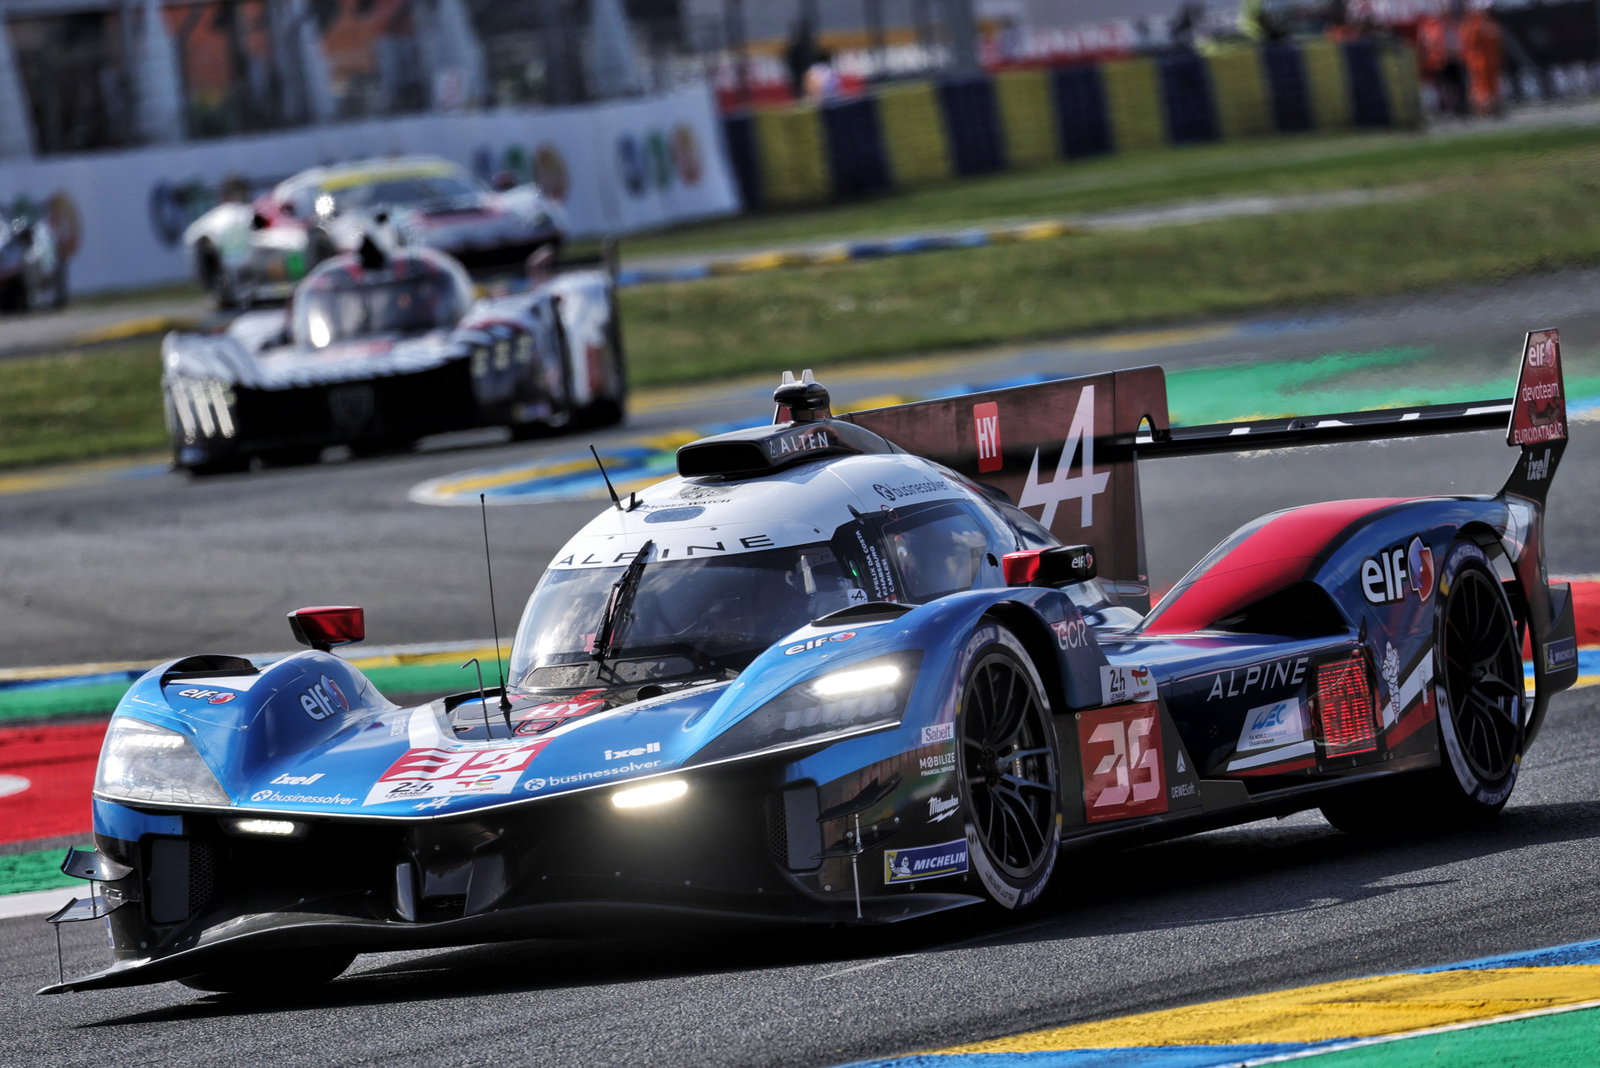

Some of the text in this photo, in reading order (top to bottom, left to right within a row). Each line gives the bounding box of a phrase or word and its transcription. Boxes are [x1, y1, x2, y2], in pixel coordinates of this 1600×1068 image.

[1528, 344, 1545, 367] elf
[1522, 382, 1559, 402] devoteam
[780, 431, 829, 454] ALTEN
[976, 415, 998, 459] HY
[1514, 423, 1564, 444] EURODATACAR
[884, 476, 950, 498] businessolver
[555, 534, 775, 567] ALPINE
[1071, 555, 1086, 569] elf
[1361, 548, 1407, 603] elf
[1057, 618, 1088, 651] GCR
[784, 636, 831, 656] elf
[1206, 656, 1309, 702] ALPINE
[178, 688, 217, 701] elf
[300, 683, 335, 721] elf
[526, 701, 596, 718] HY
[1251, 703, 1288, 731] WEC
[925, 725, 951, 742] Sabelt
[604, 742, 661, 761] ixell
[1087, 716, 1161, 808] 35
[270, 773, 326, 785] ixell
[550, 760, 662, 787] businessolver
[270, 791, 360, 806] businessolver
[913, 851, 966, 871] MICHELIN
